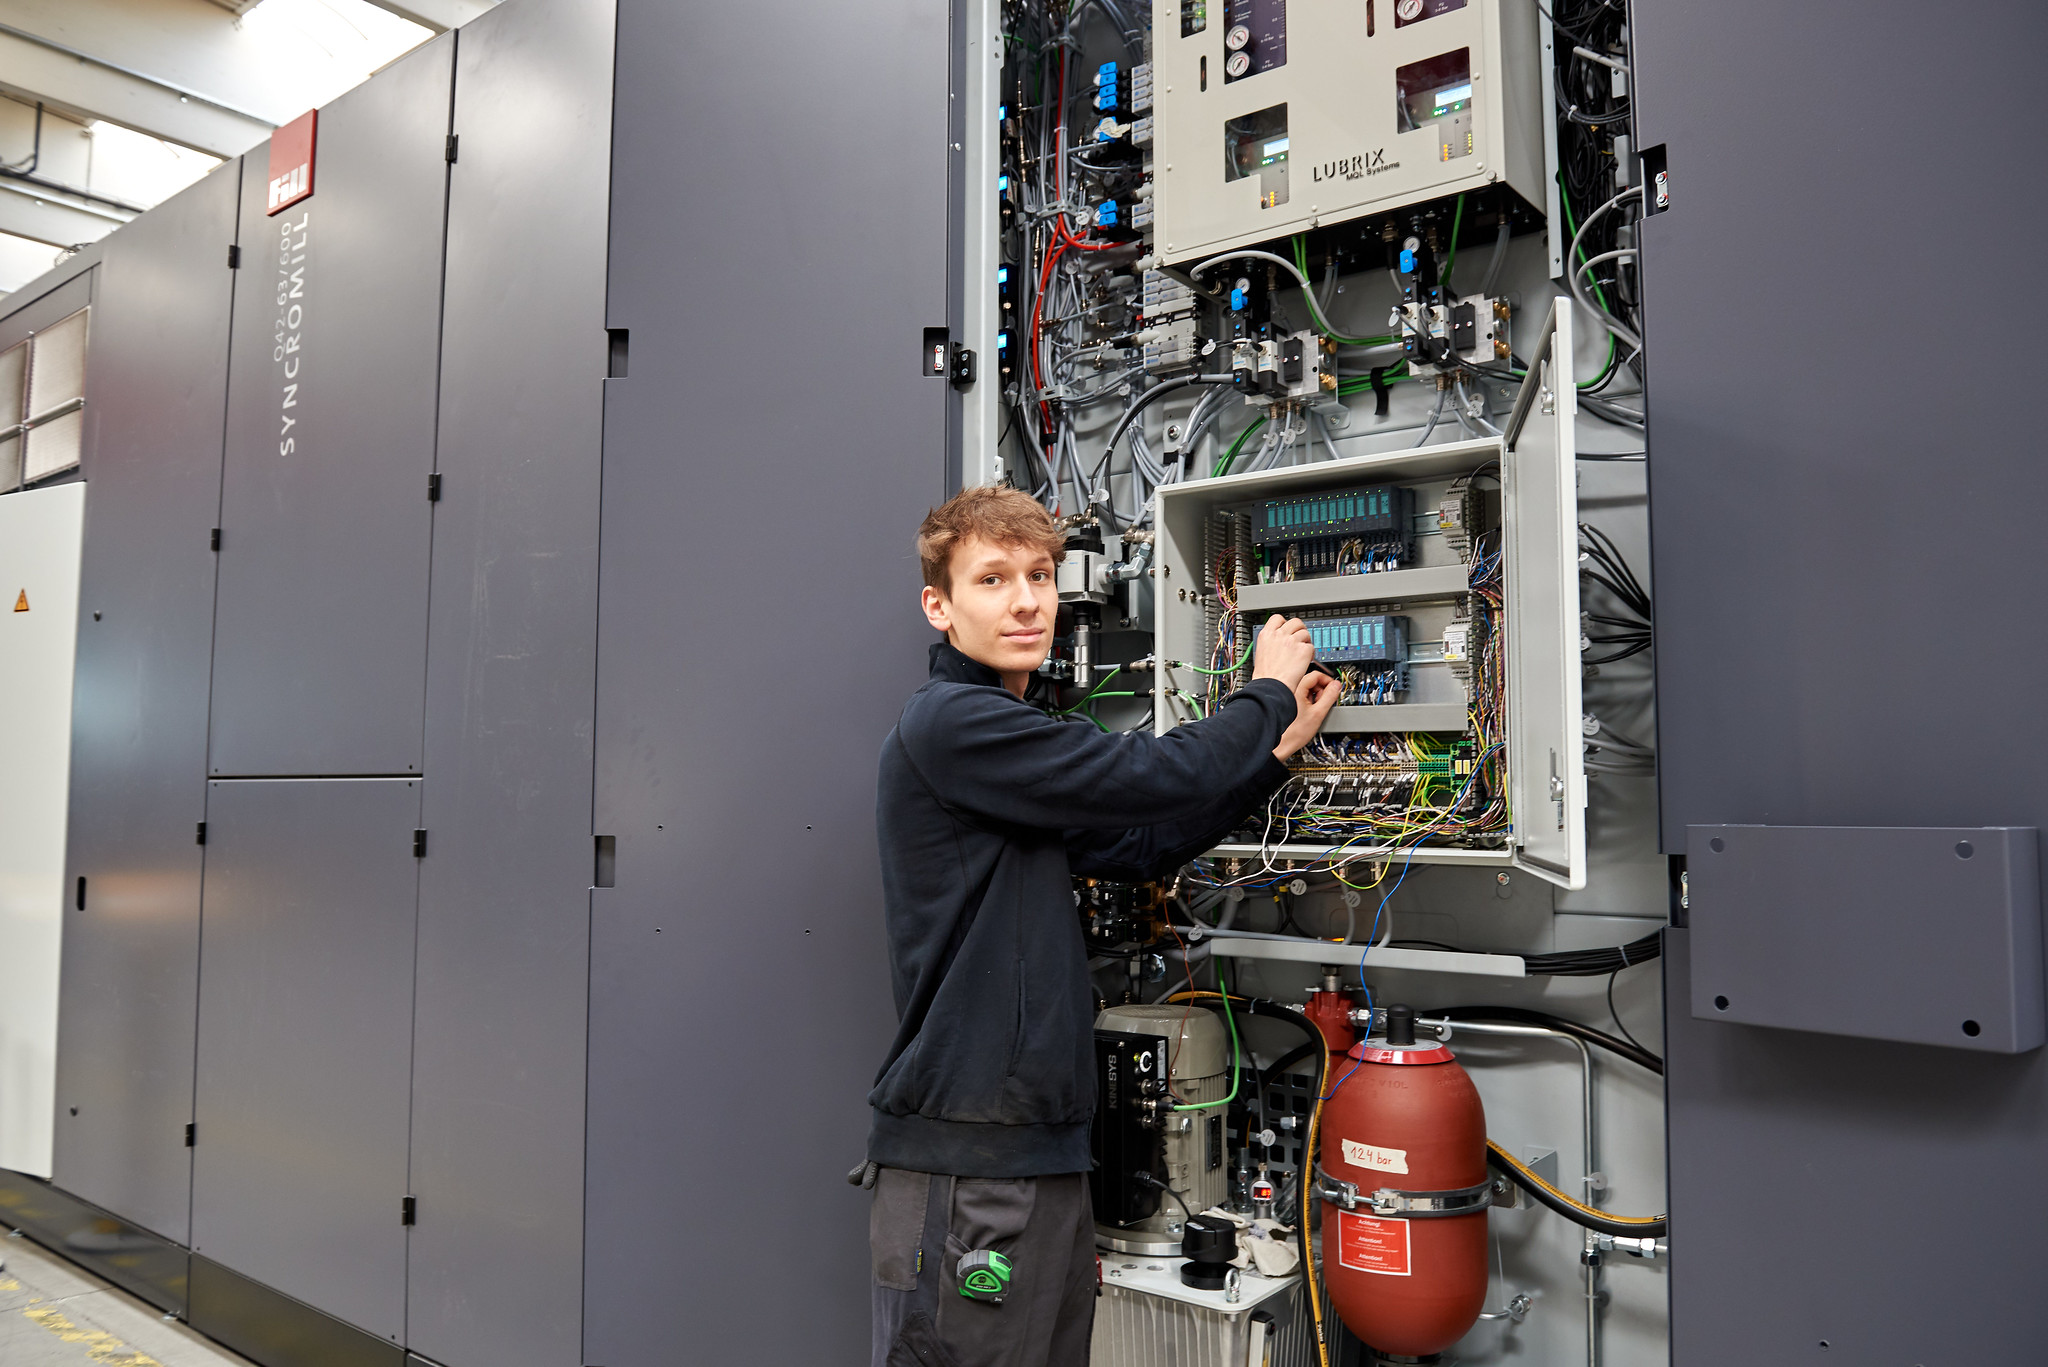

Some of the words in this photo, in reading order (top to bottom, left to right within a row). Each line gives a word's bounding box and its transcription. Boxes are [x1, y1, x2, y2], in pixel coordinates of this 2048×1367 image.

[1313, 148, 1384, 182] LUBRIX
[1346, 171, 1364, 181] MQL
[1366, 162, 1400, 175] Systems
[268, 162, 308, 209] Fill
[280, 212, 309, 457] SYNCROMILL
[1108, 1054, 1118, 1109] KINESYS
[1350, 1146, 1373, 1163] 124
[1376, 1151, 1392, 1165] bar
[1358, 1219, 1381, 1228] Achtung!
[1358, 1236, 1382, 1244] Attention!
[1358, 1253, 1383, 1261] Attention!
